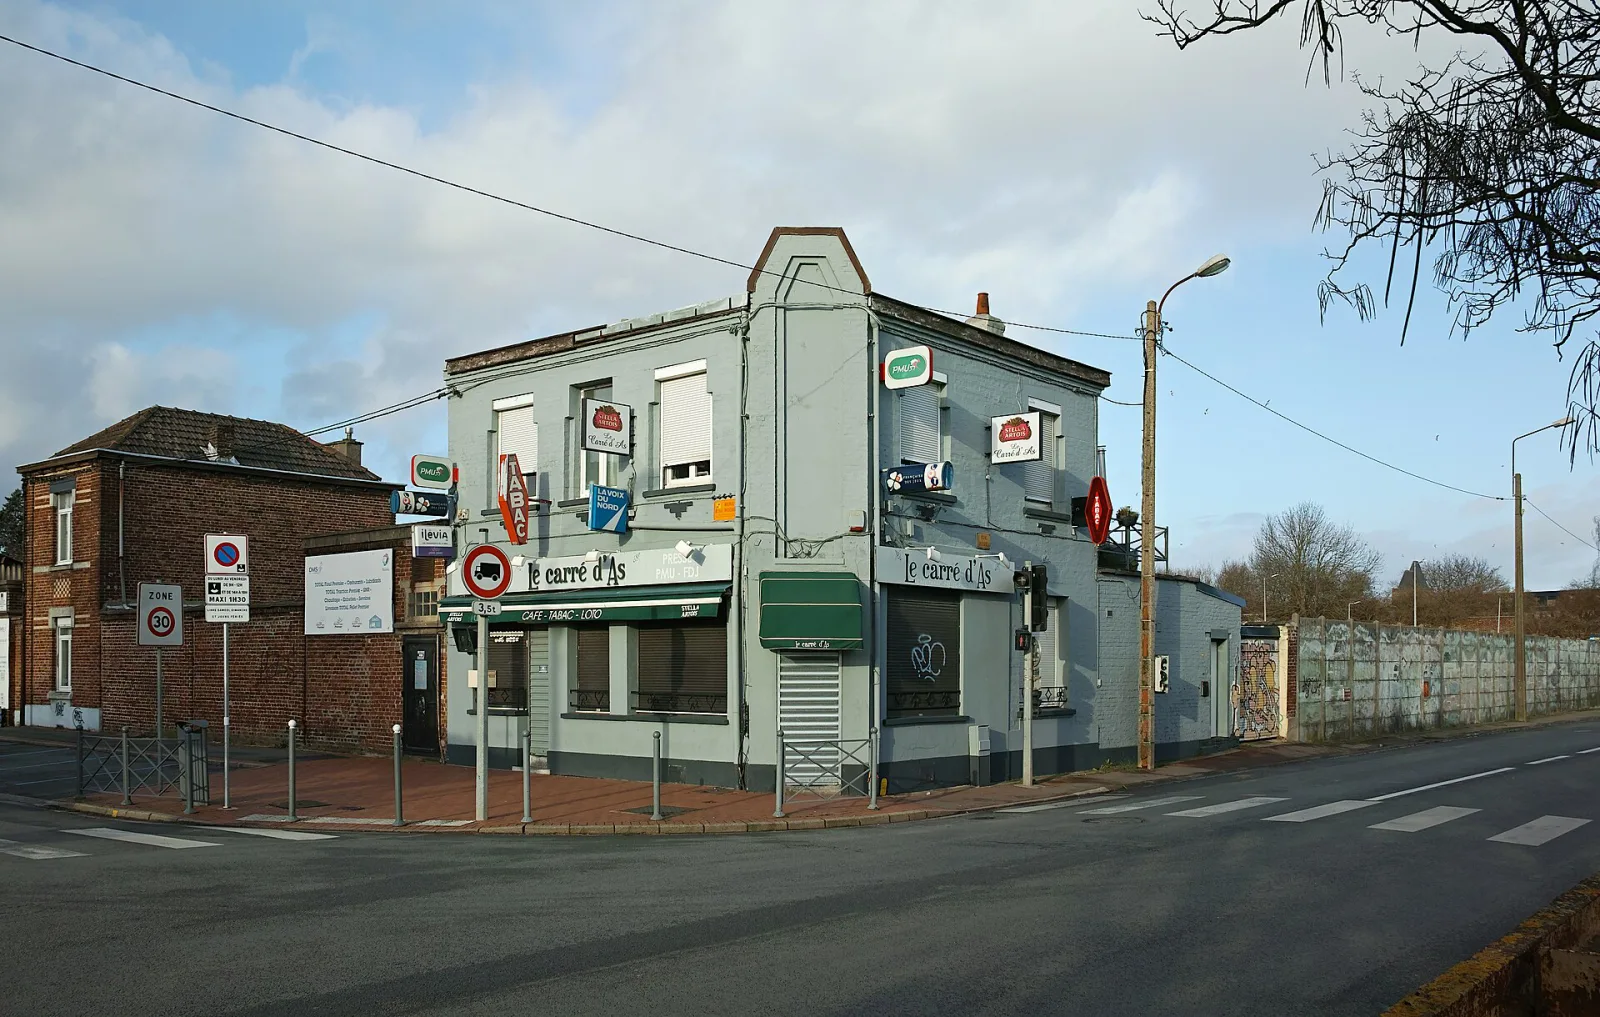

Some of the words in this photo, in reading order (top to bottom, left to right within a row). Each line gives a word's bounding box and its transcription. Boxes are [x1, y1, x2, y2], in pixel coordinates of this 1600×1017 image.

[893, 364, 910, 374] PMU
[598, 414, 618, 422] STELLA
[599, 419, 618, 428] ARTOIS
[1004, 431, 1026, 439] ARTOIS
[420, 467, 437, 477] PMU
[597, 488, 607, 496] LA
[607, 489, 625, 499] VOIX
[508, 461, 527, 538] TABAC
[597, 495, 609, 503] DU
[596, 502, 619, 511] NORD
[528, 562, 540, 590] Le
[545, 561, 587, 584] carré
[593, 554, 626, 586] d'As
[656, 567, 676, 580] PMU
[683, 566, 700, 578] FDJ
[905, 553, 917, 583] Le
[922, 562, 961, 582] carré
[965, 559, 992, 589] d'As
[148, 591, 174, 601] ZONE
[521, 610, 544, 621] CAFE
[548, 609, 575, 620] TABAC
[581, 608, 603, 620] LOTO
[153, 615, 171, 629] 30
